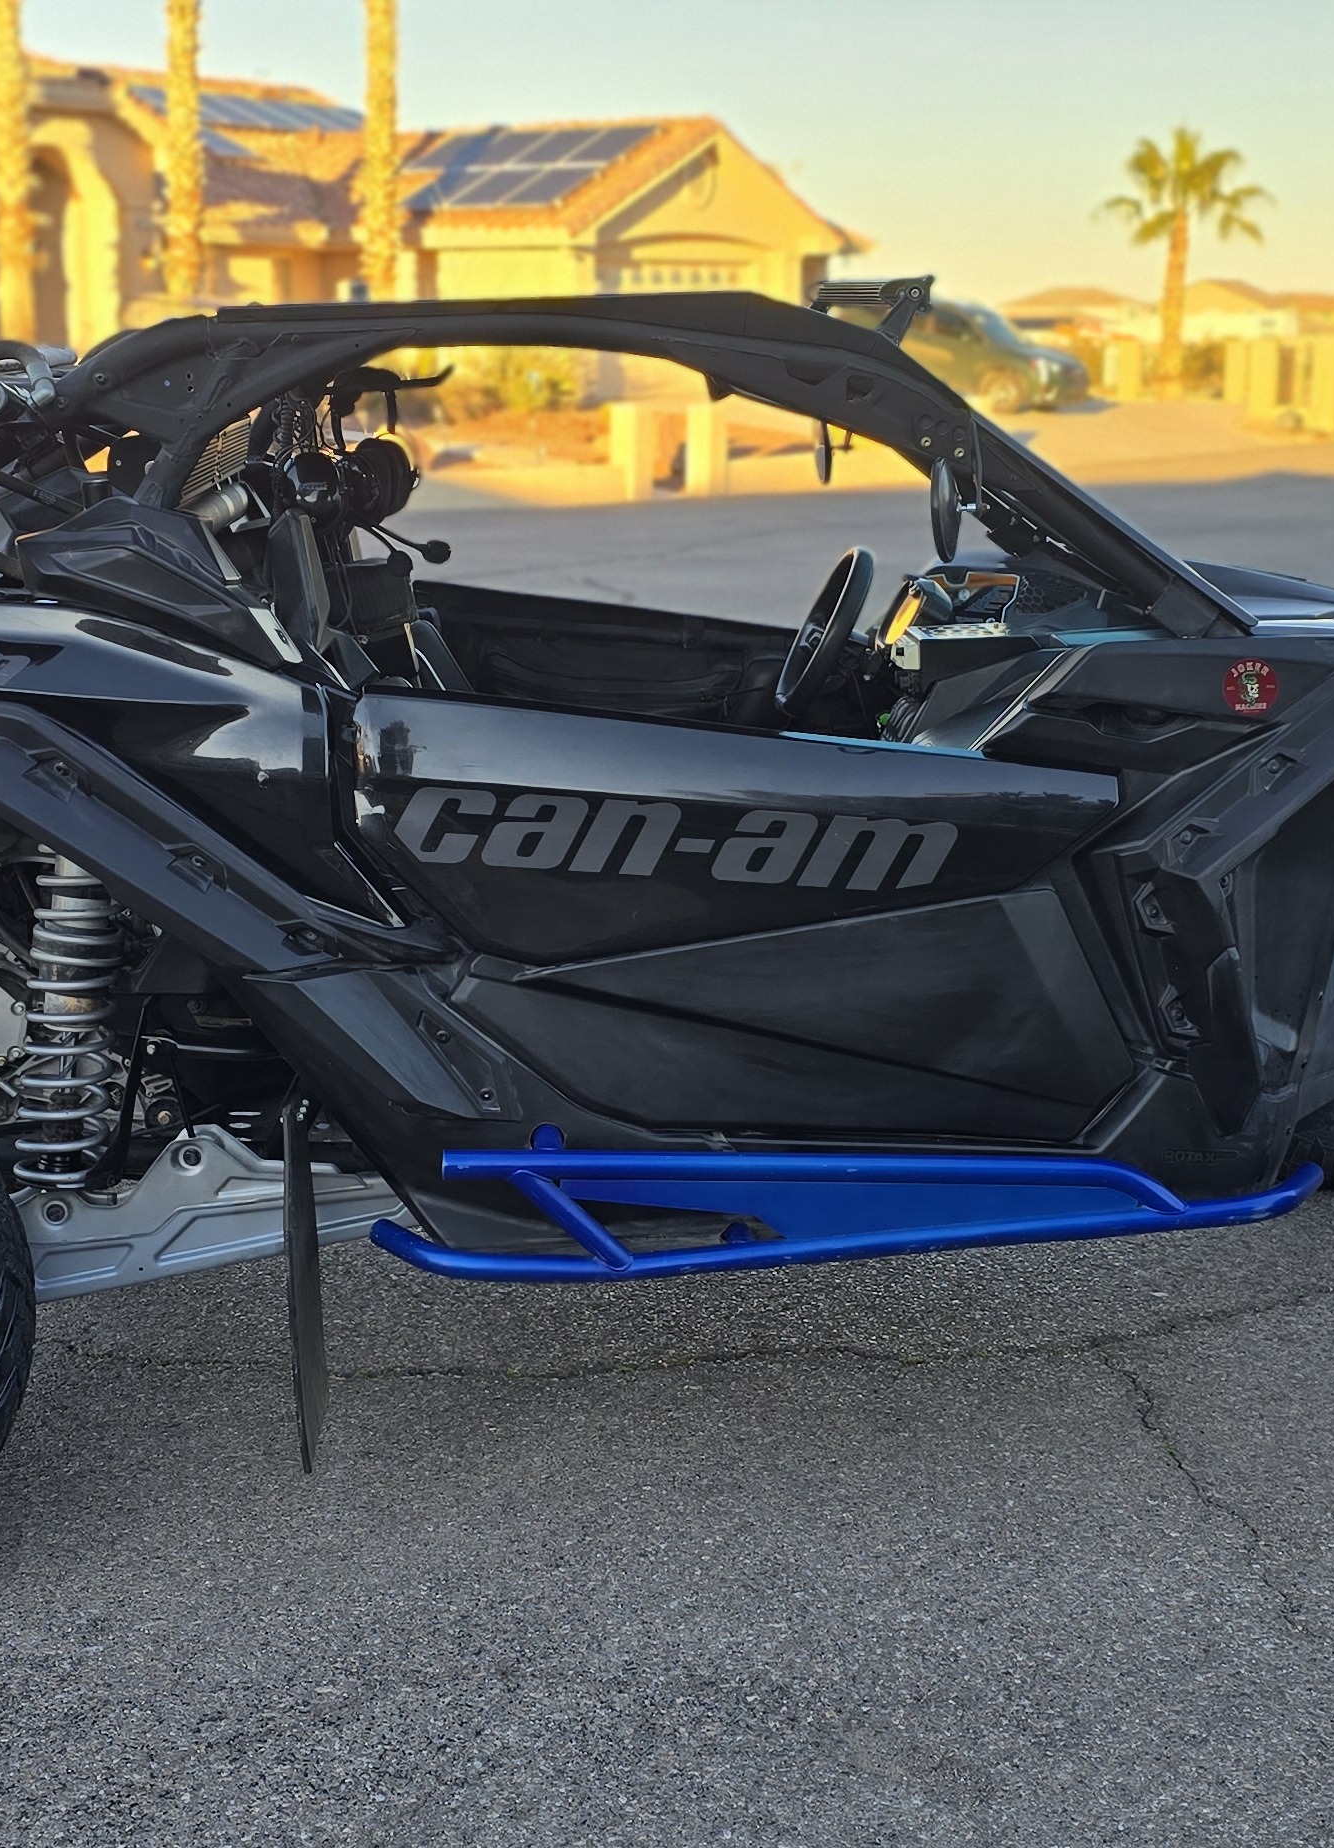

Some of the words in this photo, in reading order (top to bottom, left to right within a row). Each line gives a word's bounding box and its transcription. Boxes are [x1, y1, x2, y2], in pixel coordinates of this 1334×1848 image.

[1230, 661, 1270, 677] JOKER
[393, 785, 960, 892] can-am
[1163, 1150, 1215, 1163] ROTAX
